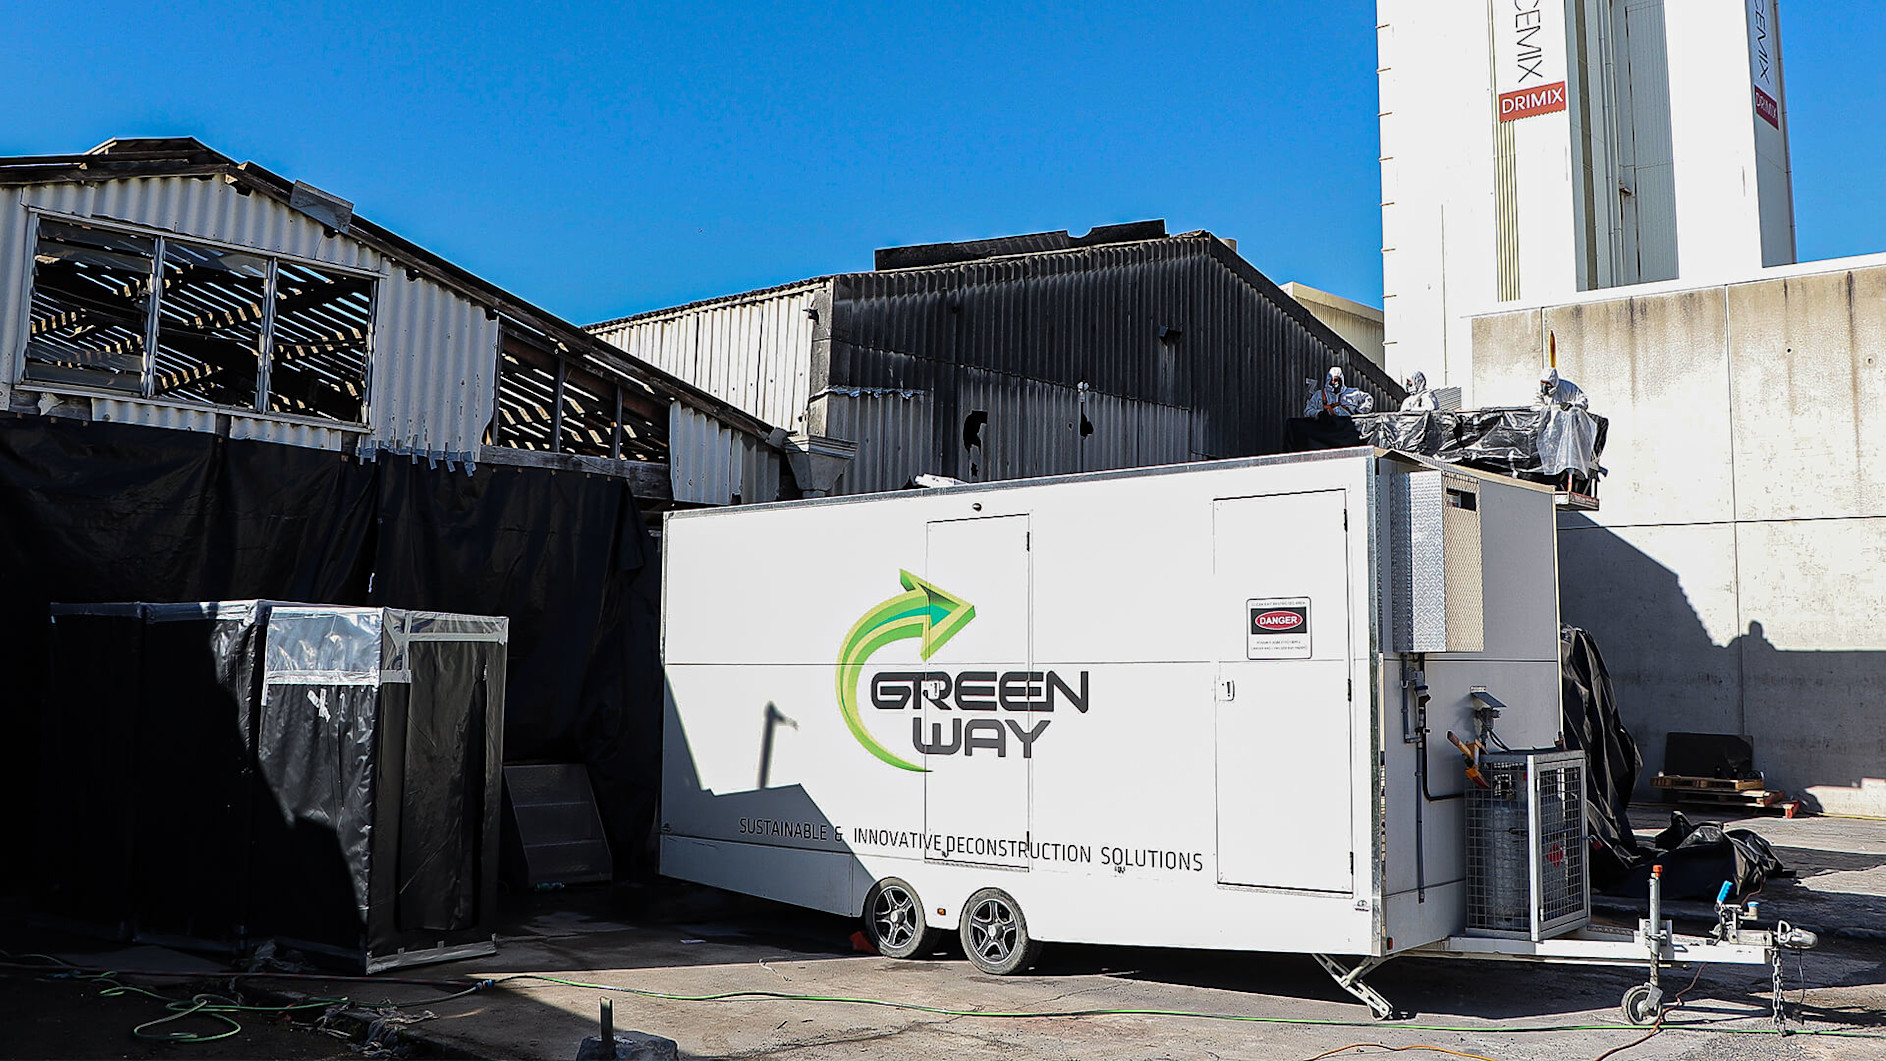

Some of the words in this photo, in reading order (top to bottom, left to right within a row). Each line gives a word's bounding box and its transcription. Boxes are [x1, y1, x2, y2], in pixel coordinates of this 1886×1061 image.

[1501, 87, 1564, 114] DRIMIX
[1259, 616, 1298, 625] DANGER
[870, 670, 1089, 714] GREEN
[912, 717, 1052, 759] WAY
[739, 817, 828, 841] SUSTAINABLE
[833, 825, 844, 842] &
[854, 827, 942, 851] INNOVATIVE
[946, 834, 1091, 863] DECONSTRUCTION
[1100, 846, 1203, 872] SOLUTIONS
